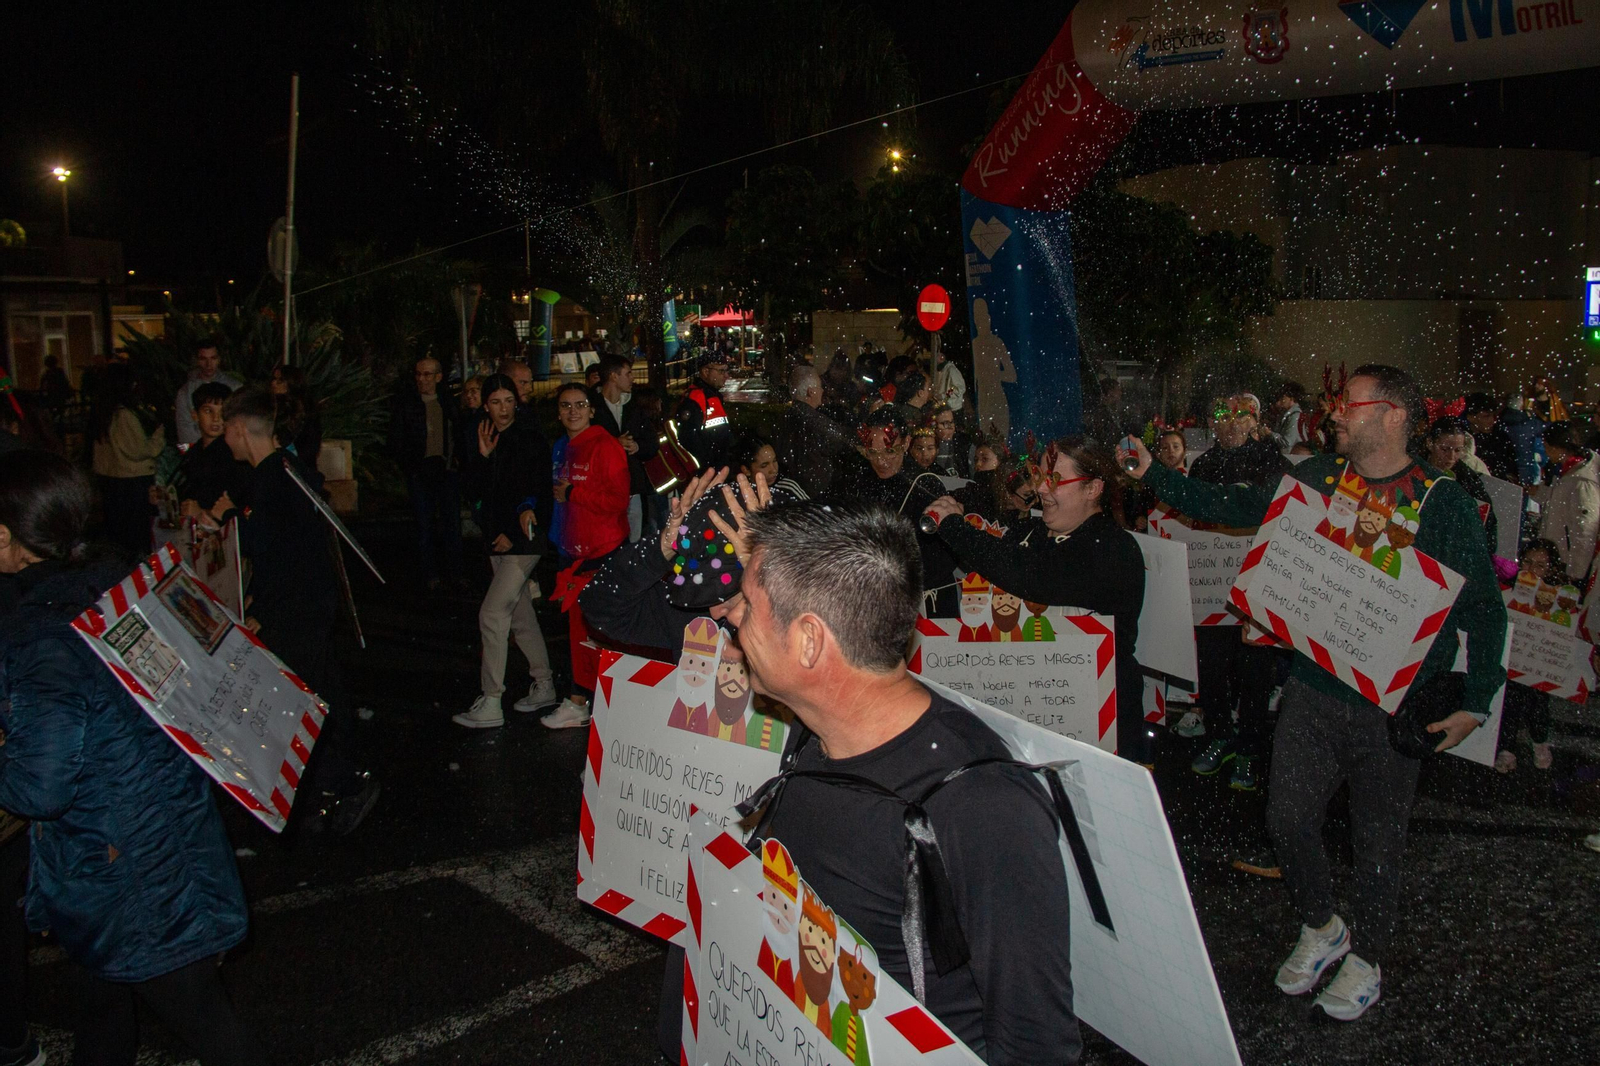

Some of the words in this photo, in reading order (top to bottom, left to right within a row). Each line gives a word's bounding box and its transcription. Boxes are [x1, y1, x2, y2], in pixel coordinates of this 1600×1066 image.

[1152, 29, 1226, 54] deportes
[974, 62, 1082, 188] Running
[1213, 536, 1242, 550] REYES
[1223, 555, 1234, 568] NO
[1279, 516, 1326, 556] QUERIDOS
[1329, 551, 1366, 579] REYES
[1370, 574, 1417, 609] MAGOS:
[1189, 577, 1223, 586] RENUEVA
[1263, 553, 1293, 581] TRAIGA
[1299, 577, 1334, 603] ILUSIÓN
[1340, 602, 1347, 612] A
[1355, 609, 1385, 635] TODAS
[1270, 540, 1291, 558] QUE
[1292, 555, 1315, 575] ESTA
[1321, 573, 1353, 599] NOCHE
[1359, 597, 1398, 625] MÁGICA
[1298, 592, 1317, 609] LAS
[1262, 584, 1310, 622] FAMILIAS
[135, 640, 174, 686] 677
[926, 652, 996, 668] QUERIDOS
[999, 653, 1035, 666] REYES
[1044, 653, 1092, 665] MAGOS:
[949, 681, 974, 690] ESTA
[982, 681, 1015, 691] NOCHE
[1029, 677, 1070, 689] MÁGICA
[1024, 695, 1032, 706] A
[1041, 694, 1076, 706] TODAS
[610, 739, 673, 781] QUERIDOS
[682, 764, 724, 797] REYES
[620, 780, 634, 802] LA
[642, 788, 690, 823] ILUSIÓN
[616, 808, 653, 840] QUIEN
[658, 826, 675, 849] SE
[709, 941, 785, 1043] QUERIDOS
[708, 990, 731, 1036] QUE
[736, 1019, 751, 1057] LA
